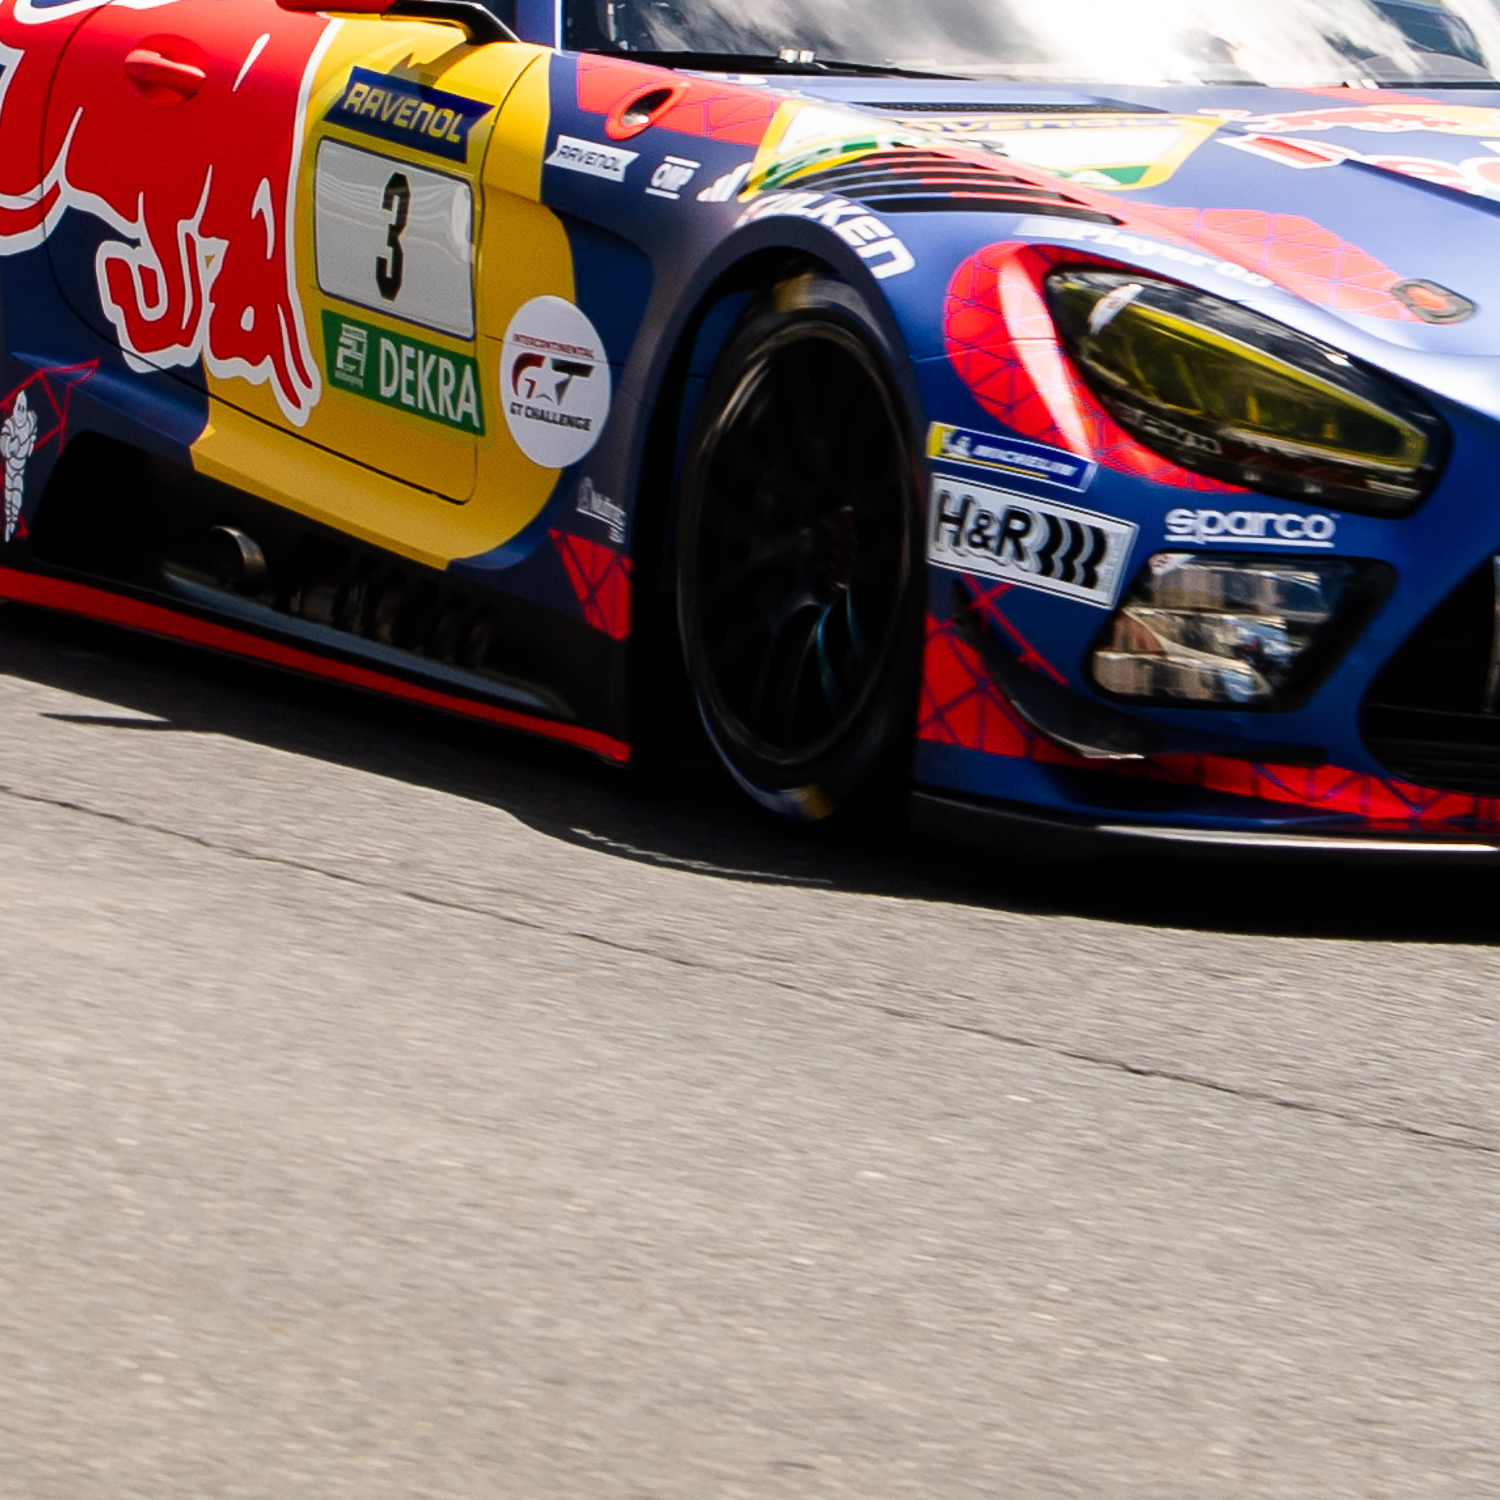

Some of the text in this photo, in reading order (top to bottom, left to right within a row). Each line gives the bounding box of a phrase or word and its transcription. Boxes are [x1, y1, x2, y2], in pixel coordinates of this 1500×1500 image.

[341, 82, 464, 143] RAVENOL
[556, 144, 621, 173] RAVENOL
[375, 171, 411, 302] 3
[379, 336, 481, 430] DEKRA
[509, 401, 593, 431] GT CHALLENGE
[935, 488, 1034, 563] H&R
[1164, 508, 1337, 545] sparco
